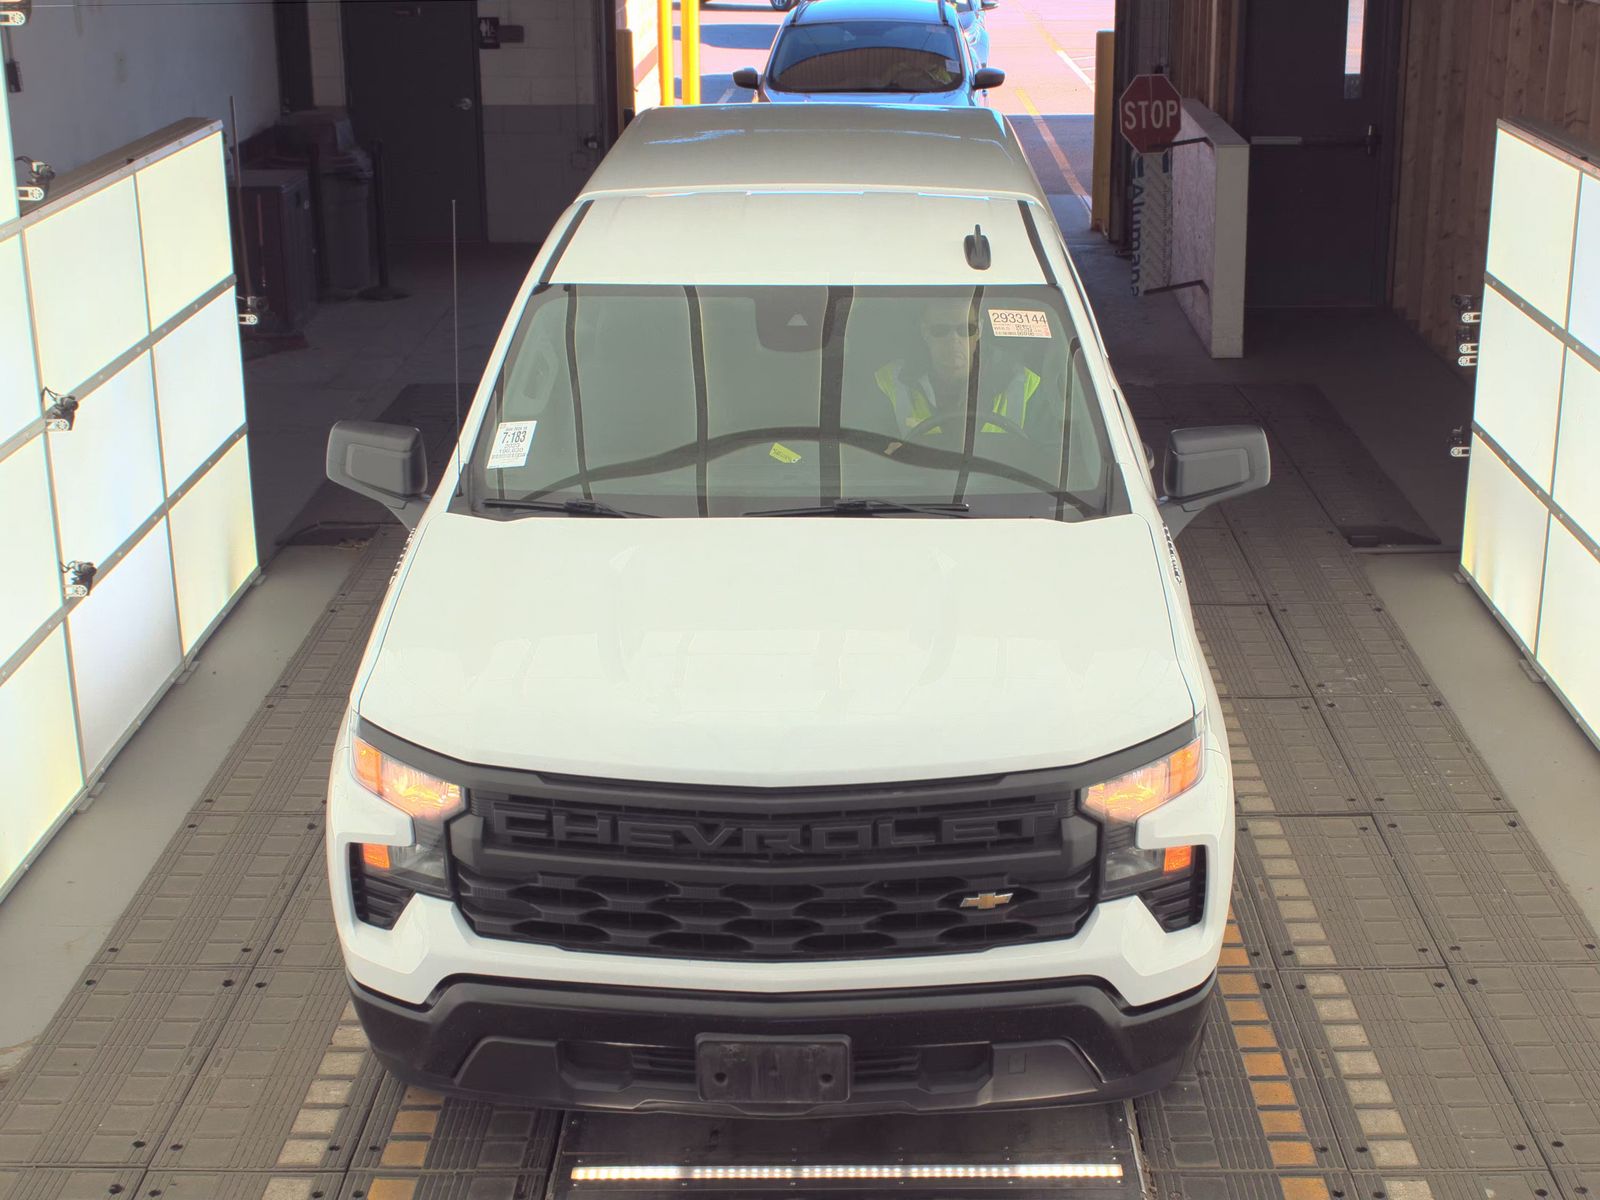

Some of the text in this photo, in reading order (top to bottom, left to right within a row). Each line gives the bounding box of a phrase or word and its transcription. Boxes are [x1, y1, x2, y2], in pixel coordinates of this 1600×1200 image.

[1124, 99, 1178, 130] STOP
[992, 312, 1047, 324] 2933144
[502, 431, 526, 444] 7:183
[493, 803, 1057, 853] CHEVROLET
